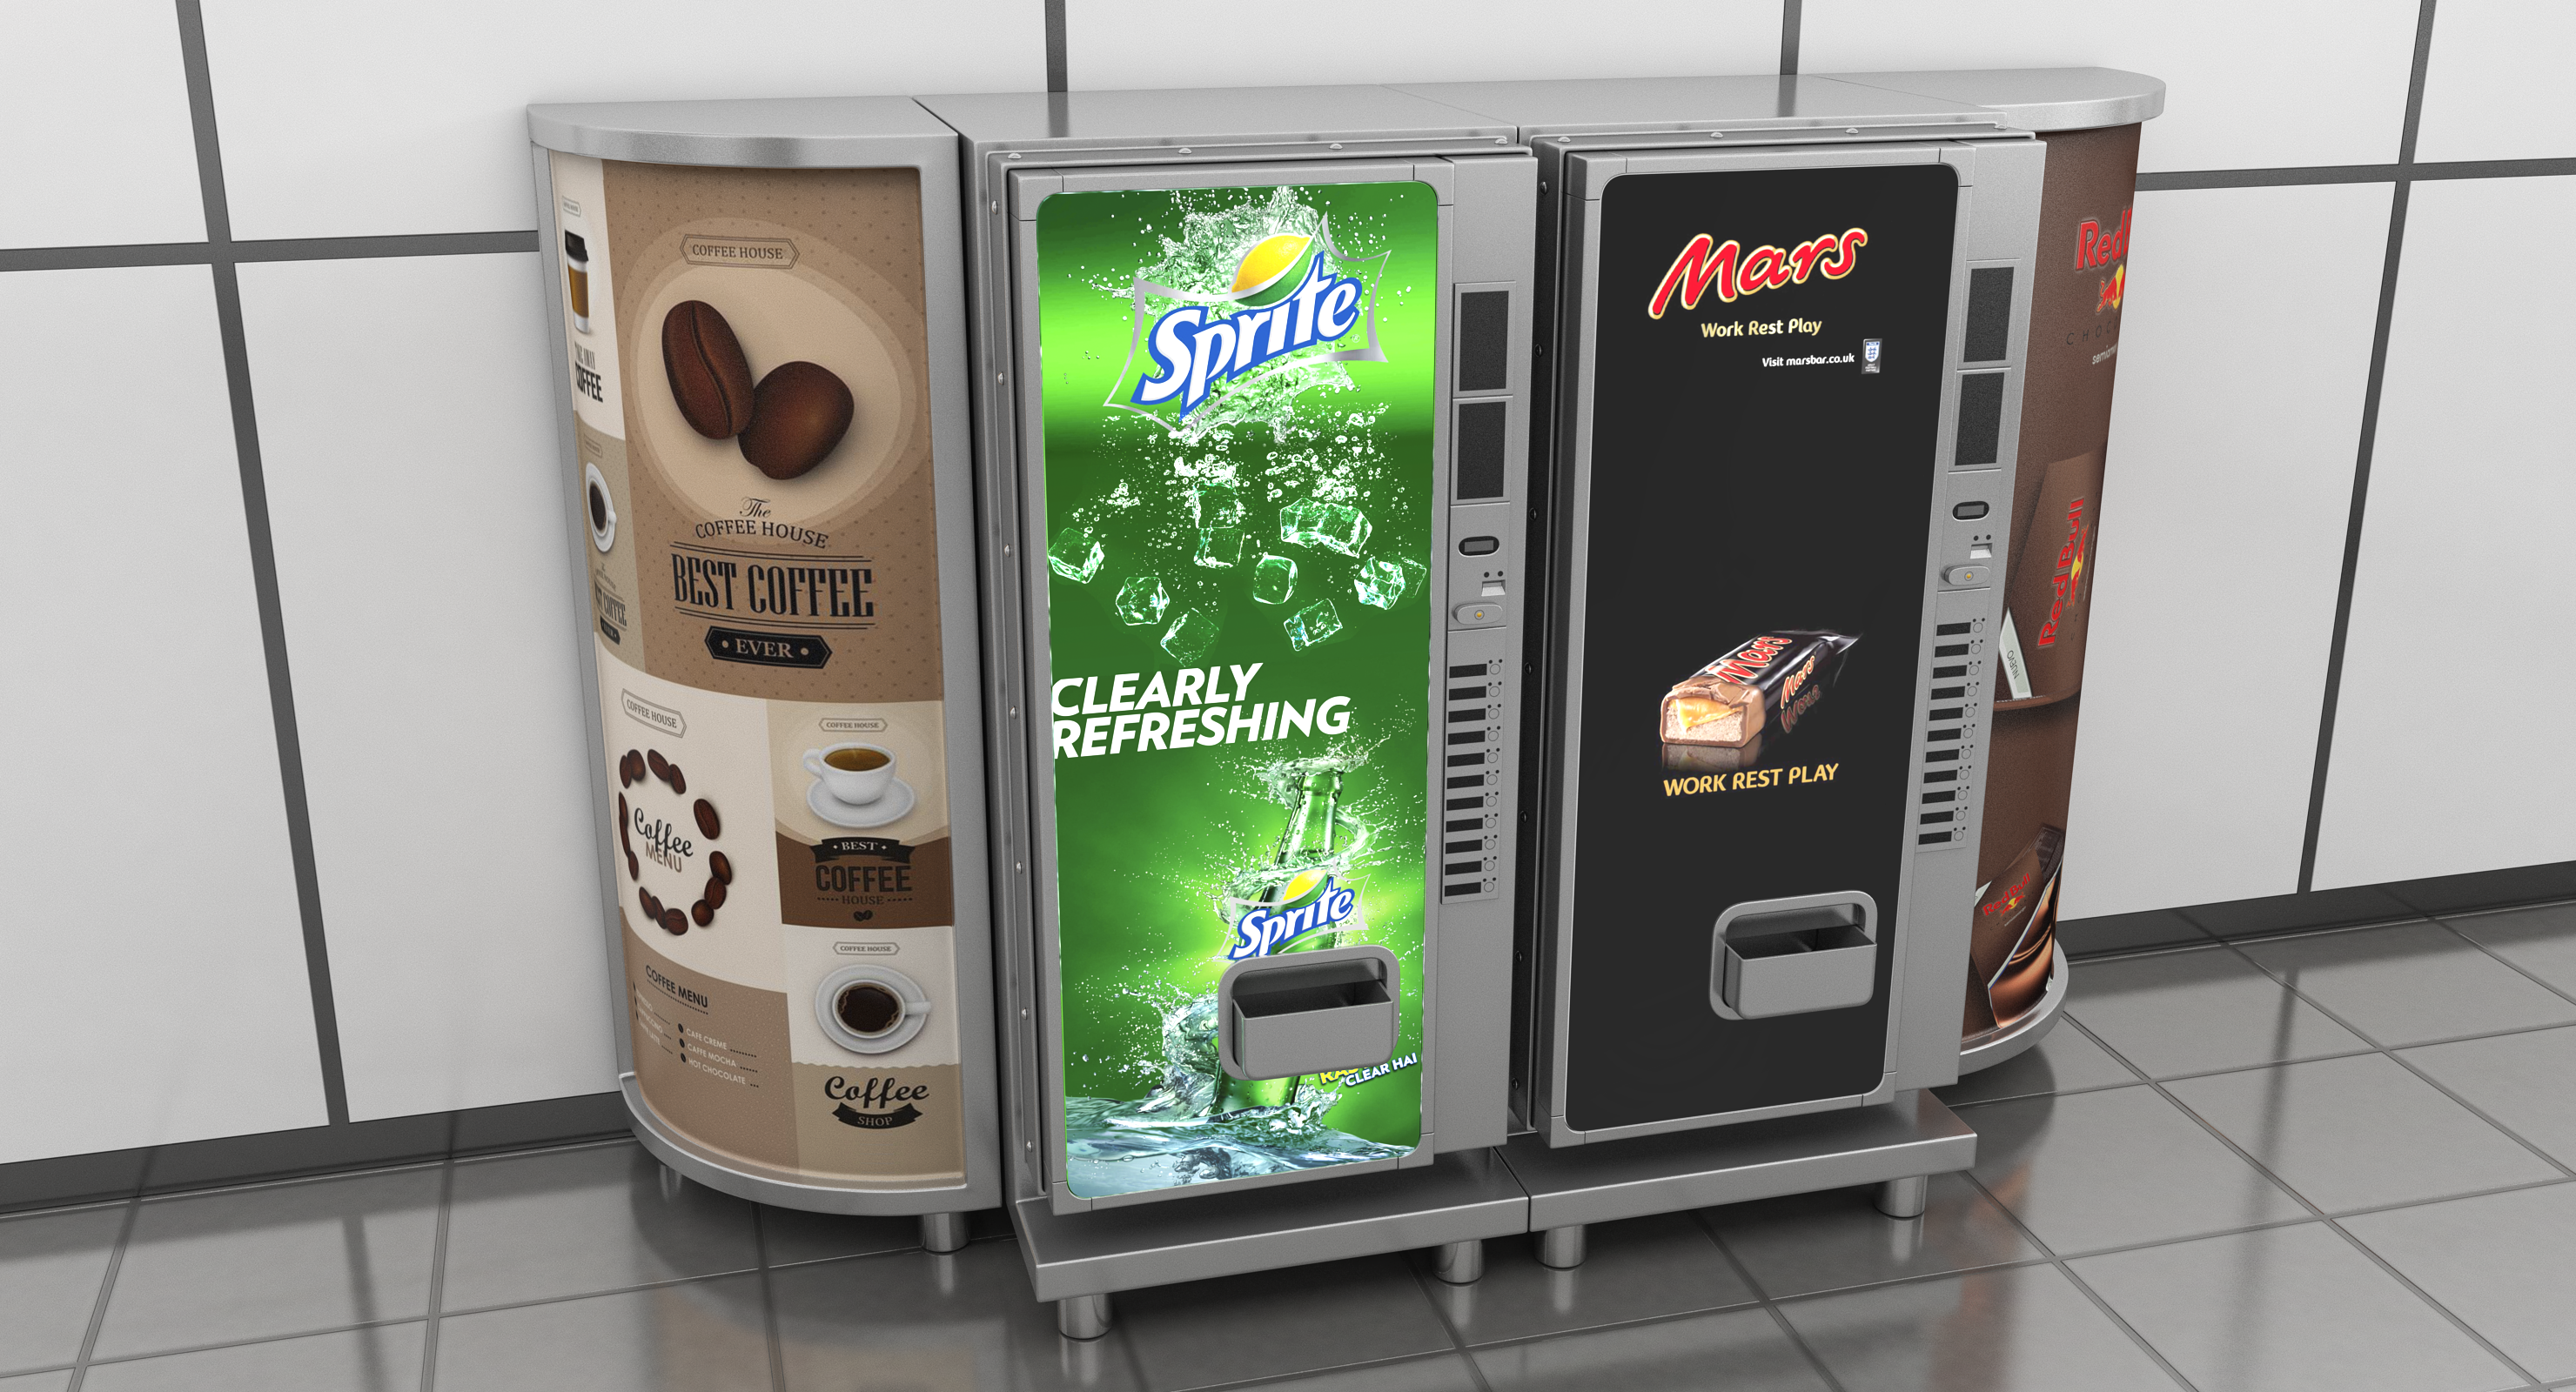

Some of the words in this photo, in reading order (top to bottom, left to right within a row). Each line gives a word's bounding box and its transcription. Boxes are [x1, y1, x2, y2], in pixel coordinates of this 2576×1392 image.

[692, 244, 737, 258] COFFEE
[739, 246, 783, 259] HOUSE
[1648, 227, 1868, 320] Mars
[1130, 250, 1363, 424] Sprite
[1701, 320, 1744, 338] Work
[1748, 319, 1784, 336] Rest
[1788, 318, 1823, 336] Play
[1761, 357, 1784, 367] Visit
[1786, 353, 1855, 366] marsbar.co.uk
[740, 496, 771, 519] The
[695, 519, 756, 539] COFFEE
[762, 522, 828, 549] HOUSE
[671, 553, 737, 610] BEST
[748, 565, 874, 618] COFFEE
[735, 638, 794, 658] EVER
[1705, 636, 1792, 685] Mars
[1051, 662, 1264, 717] CLEARLY
[1781, 655, 1815, 709] Mars
[627, 699, 650, 719] COFFEE
[651, 711, 677, 728] HOUSE
[1054, 695, 1352, 760] REFRESHING
[1663, 773, 1727, 796] WORK
[1732, 768, 1783, 790] REST
[1788, 763, 1839, 785] PLAY
[634, 807, 694, 857] Coffee
[841, 841, 879, 851] BEST
[646, 840, 682, 873] MENU
[815, 865, 913, 893] COFFEE
[842, 895, 885, 906] HOUSE
[1228, 877, 1356, 960] Sprite
[646, 965, 676, 994] COFFEE
[678, 985, 708, 1008] MENU
[686, 1027, 703, 1041] CAFE
[703, 1035, 728, 1050] CREME
[687, 1043, 707, 1058] CAFFE
[708, 1052, 737, 1067] MOCHA
[1345, 1063, 1391, 1086] CLEAR
[1392, 1053, 1418, 1070] HAI
[688, 1057, 701, 1068] HOT
[701, 1064, 747, 1085] CHOCOLATE
[824, 1076, 929, 1108] Coffee
[857, 1115, 893, 1126] SHOP
